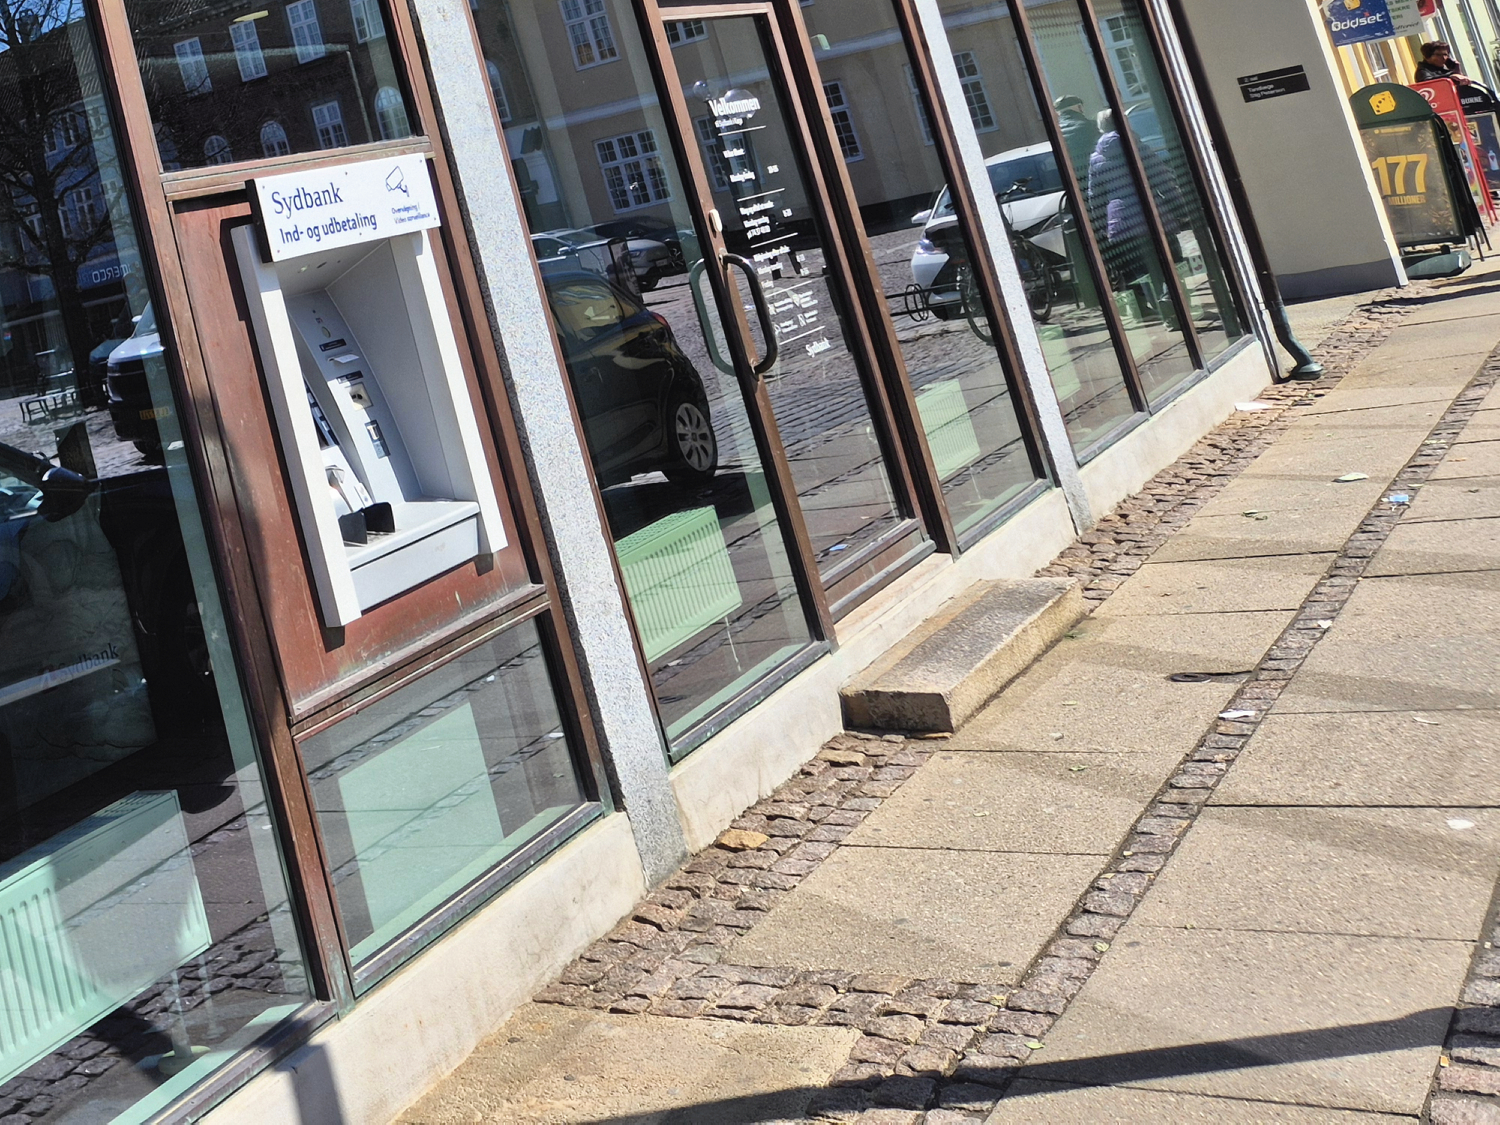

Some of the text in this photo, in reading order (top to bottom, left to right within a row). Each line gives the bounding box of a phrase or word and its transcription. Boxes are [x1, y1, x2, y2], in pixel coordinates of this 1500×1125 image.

[1331, 12, 1384, 32] Oddset
[708, 96, 761, 118] Velkommen
[1371, 153, 1428, 196] 177
[271, 182, 344, 219] Sydbank
[1388, 194, 1427, 206] MILLIONER
[279, 212, 378, 244] Ind- og udbetaling
